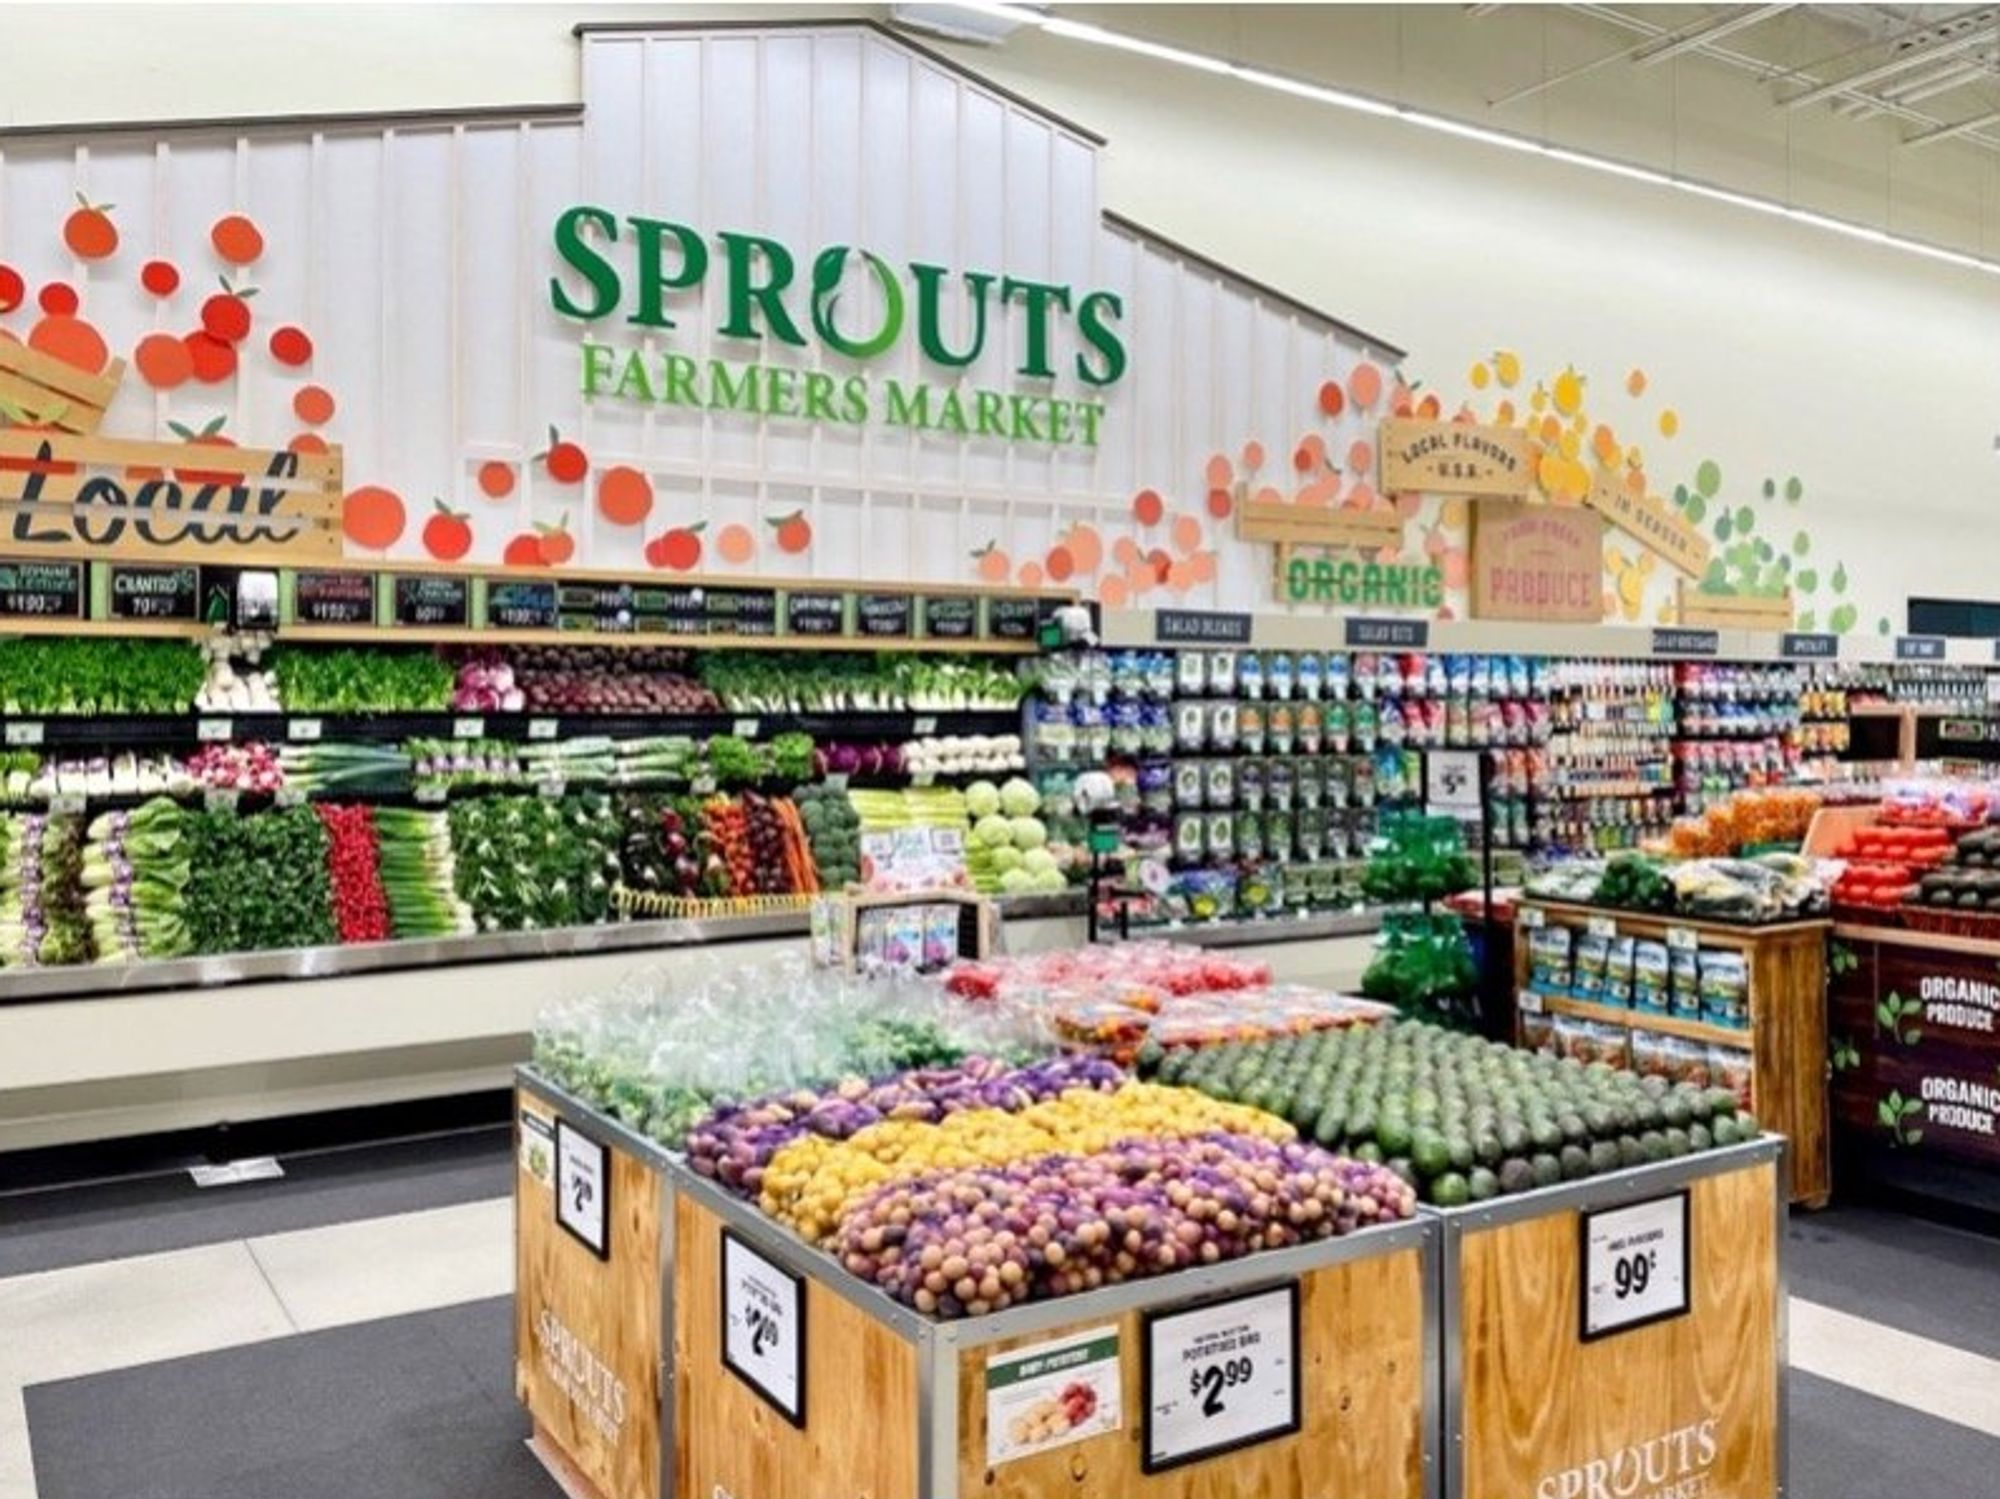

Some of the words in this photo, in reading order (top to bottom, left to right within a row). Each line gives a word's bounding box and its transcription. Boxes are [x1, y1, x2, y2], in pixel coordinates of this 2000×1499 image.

[550, 206, 1127, 387] SPROUTS
[580, 343, 868, 424] FARMERS
[884, 379, 1106, 447] MARKET
[1401, 434, 1448, 464] LOCAL
[1453, 432, 1517, 472] FLAVORS
[13, 440, 298, 546] Local
[1289, 559, 1442, 608] ORGANIC
[1490, 567, 1594, 607] PRODUCE
[1920, 976, 2000, 1010] ORGANIC
[1926, 1002, 1994, 1032] PRODUCE
[1921, 1076, 2000, 1113] ORGANIC
[1928, 1103, 1995, 1134] PRODUCE
[1614, 1248, 1657, 1300] 99¢
